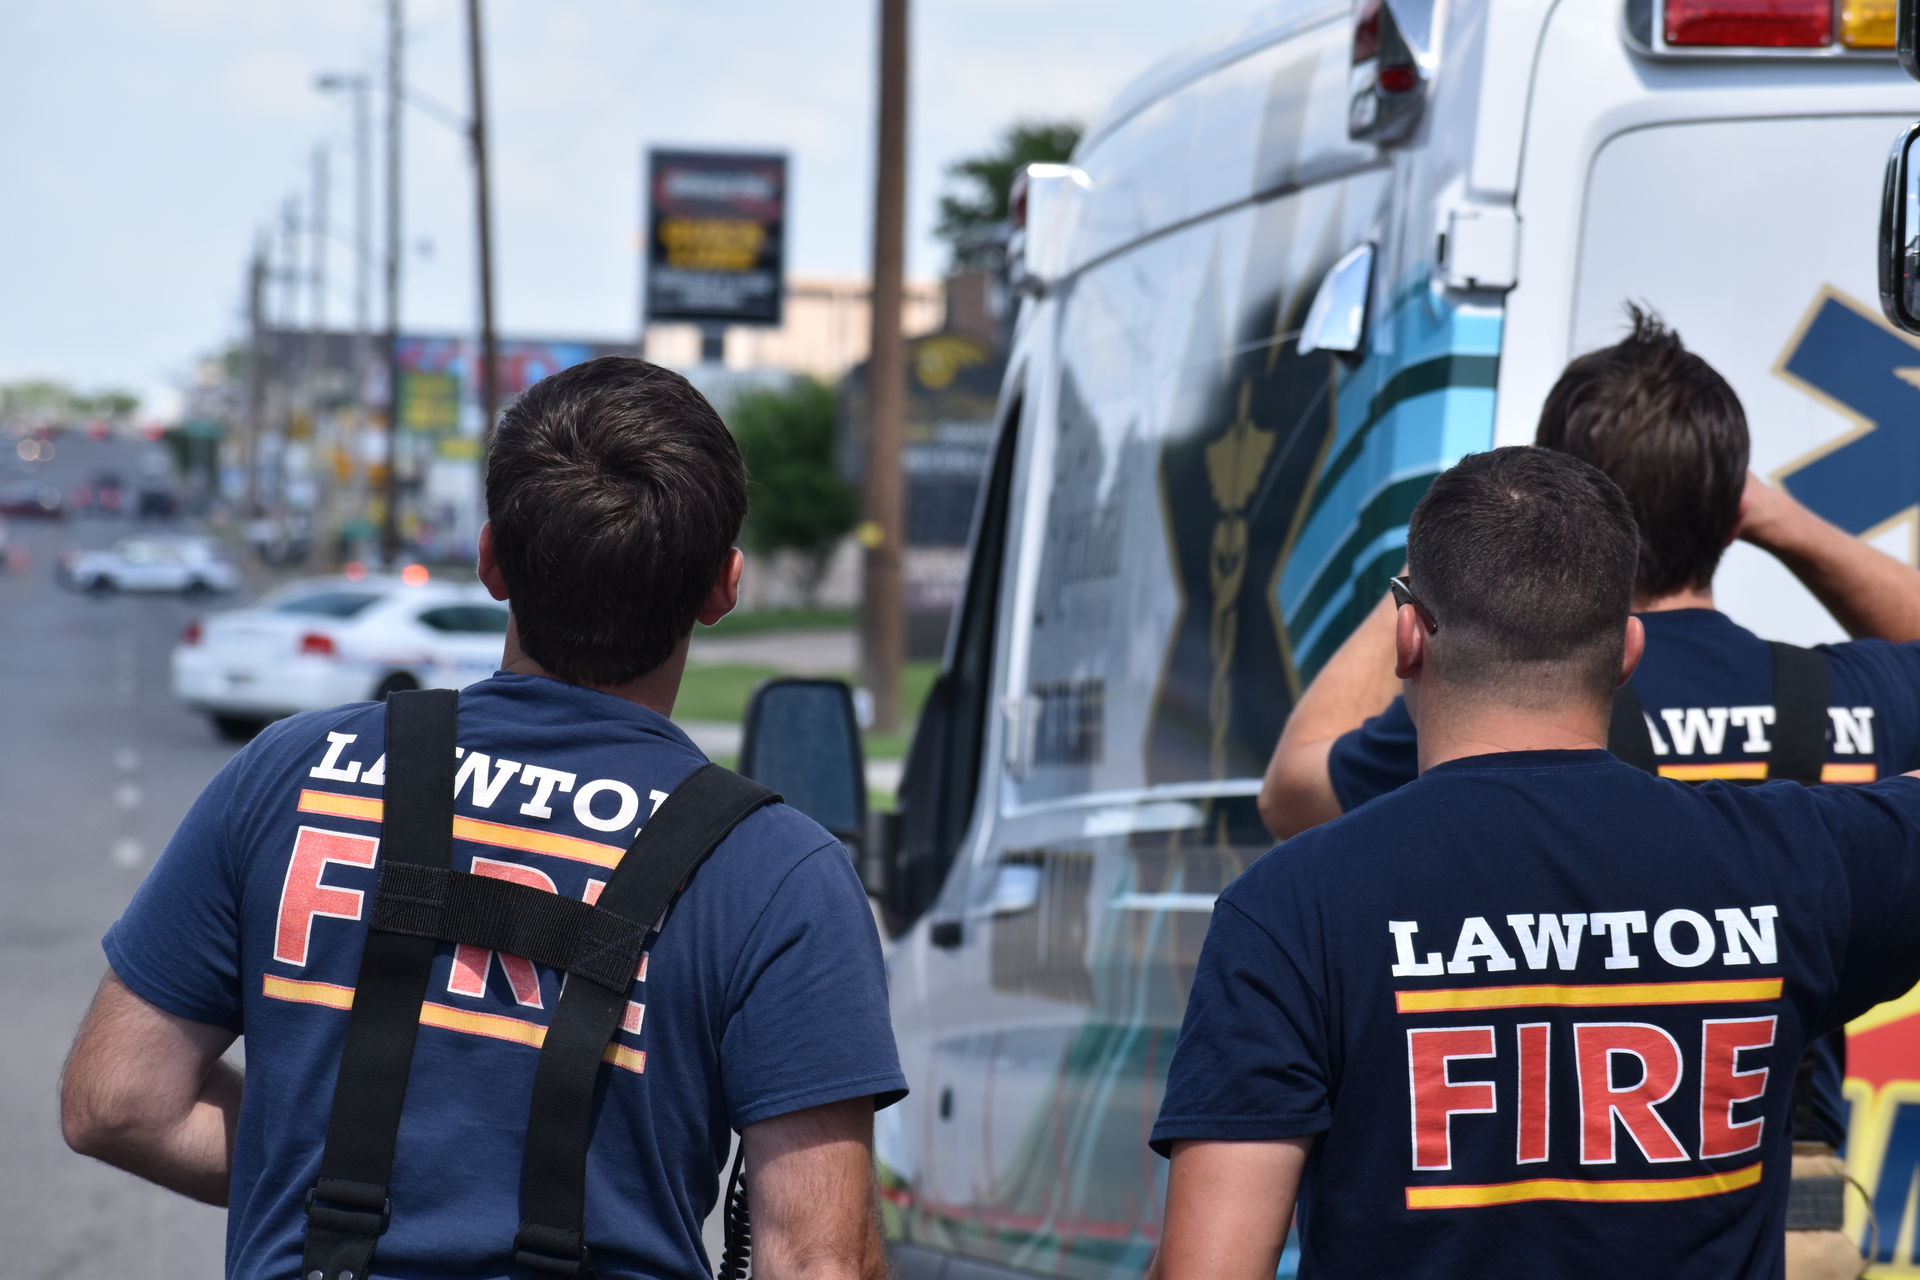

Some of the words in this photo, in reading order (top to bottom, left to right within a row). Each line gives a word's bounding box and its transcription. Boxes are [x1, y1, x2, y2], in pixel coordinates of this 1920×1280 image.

[309, 731, 670, 838] LWTO
[1389, 905, 1779, 977] LAWTON
[1407, 1015, 1778, 1171] FIRE
